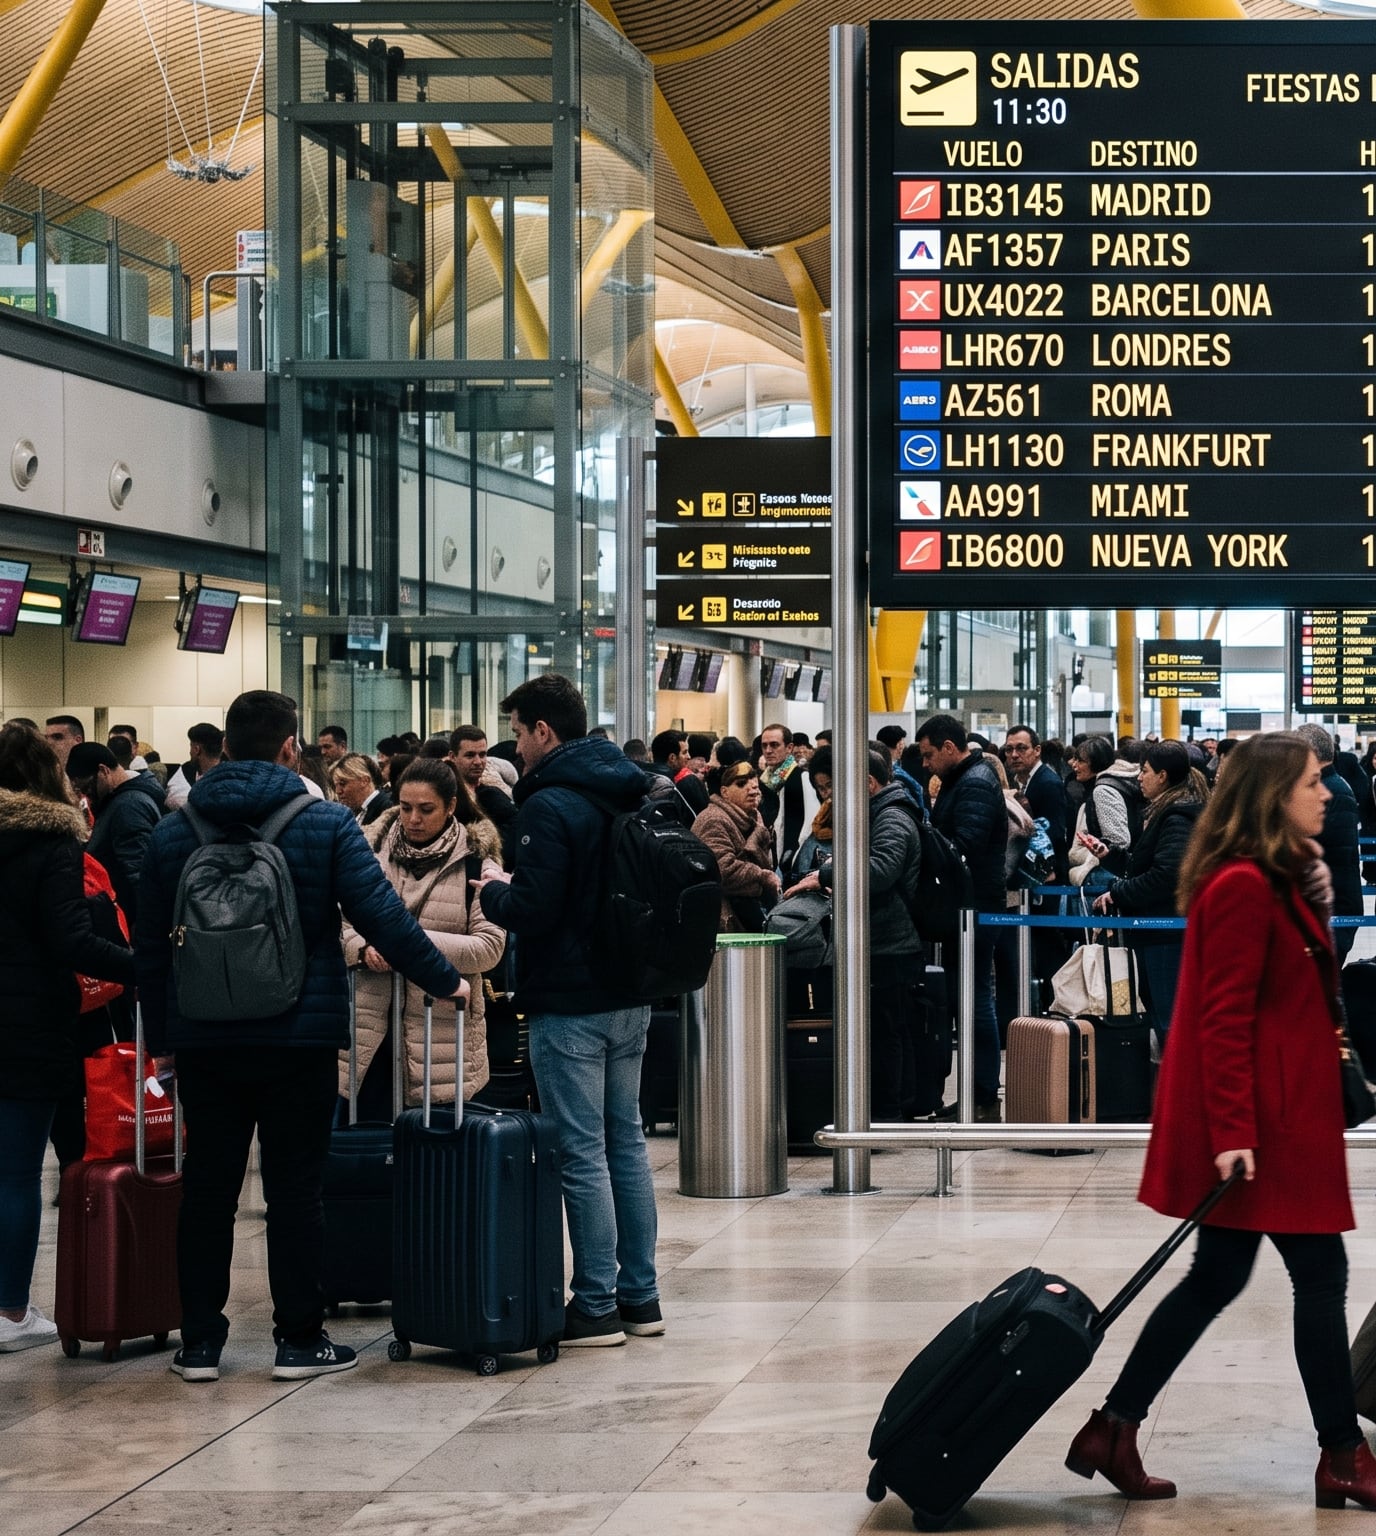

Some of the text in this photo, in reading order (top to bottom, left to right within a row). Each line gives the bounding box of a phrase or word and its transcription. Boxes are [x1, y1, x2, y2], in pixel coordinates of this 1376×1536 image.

[991, 53, 1139, 88] SALIDAS
[1248, 74, 1360, 102] FIESTAS
[993, 98, 1067, 125] 11:30
[944, 141, 1022, 166] VUELO
[1091, 141, 1197, 166] DESTINO
[947, 183, 1063, 216] IB3145
[1092, 183, 1210, 216] MADRID
[944, 233, 1063, 266] AF1357
[1092, 233, 1190, 266] PARIS
[945, 283, 1063, 317] UX4022
[1092, 283, 1272, 317] BARCELONA
[946, 334, 1063, 366] LHR670
[1093, 334, 1230, 366] LONDRES
[945, 384, 1039, 416] AZ561
[1092, 384, 1172, 416] ROMA
[946, 434, 1063, 466] LH1130
[1093, 434, 1271, 466] FRANKFURT
[945, 484, 1039, 517] AA991
[1092, 484, 1189, 517] MIAMI
[947, 534, 1063, 567] IB6800
[1092, 535, 1191, 567] NUEVA
[1208, 534, 1288, 567] YORK
